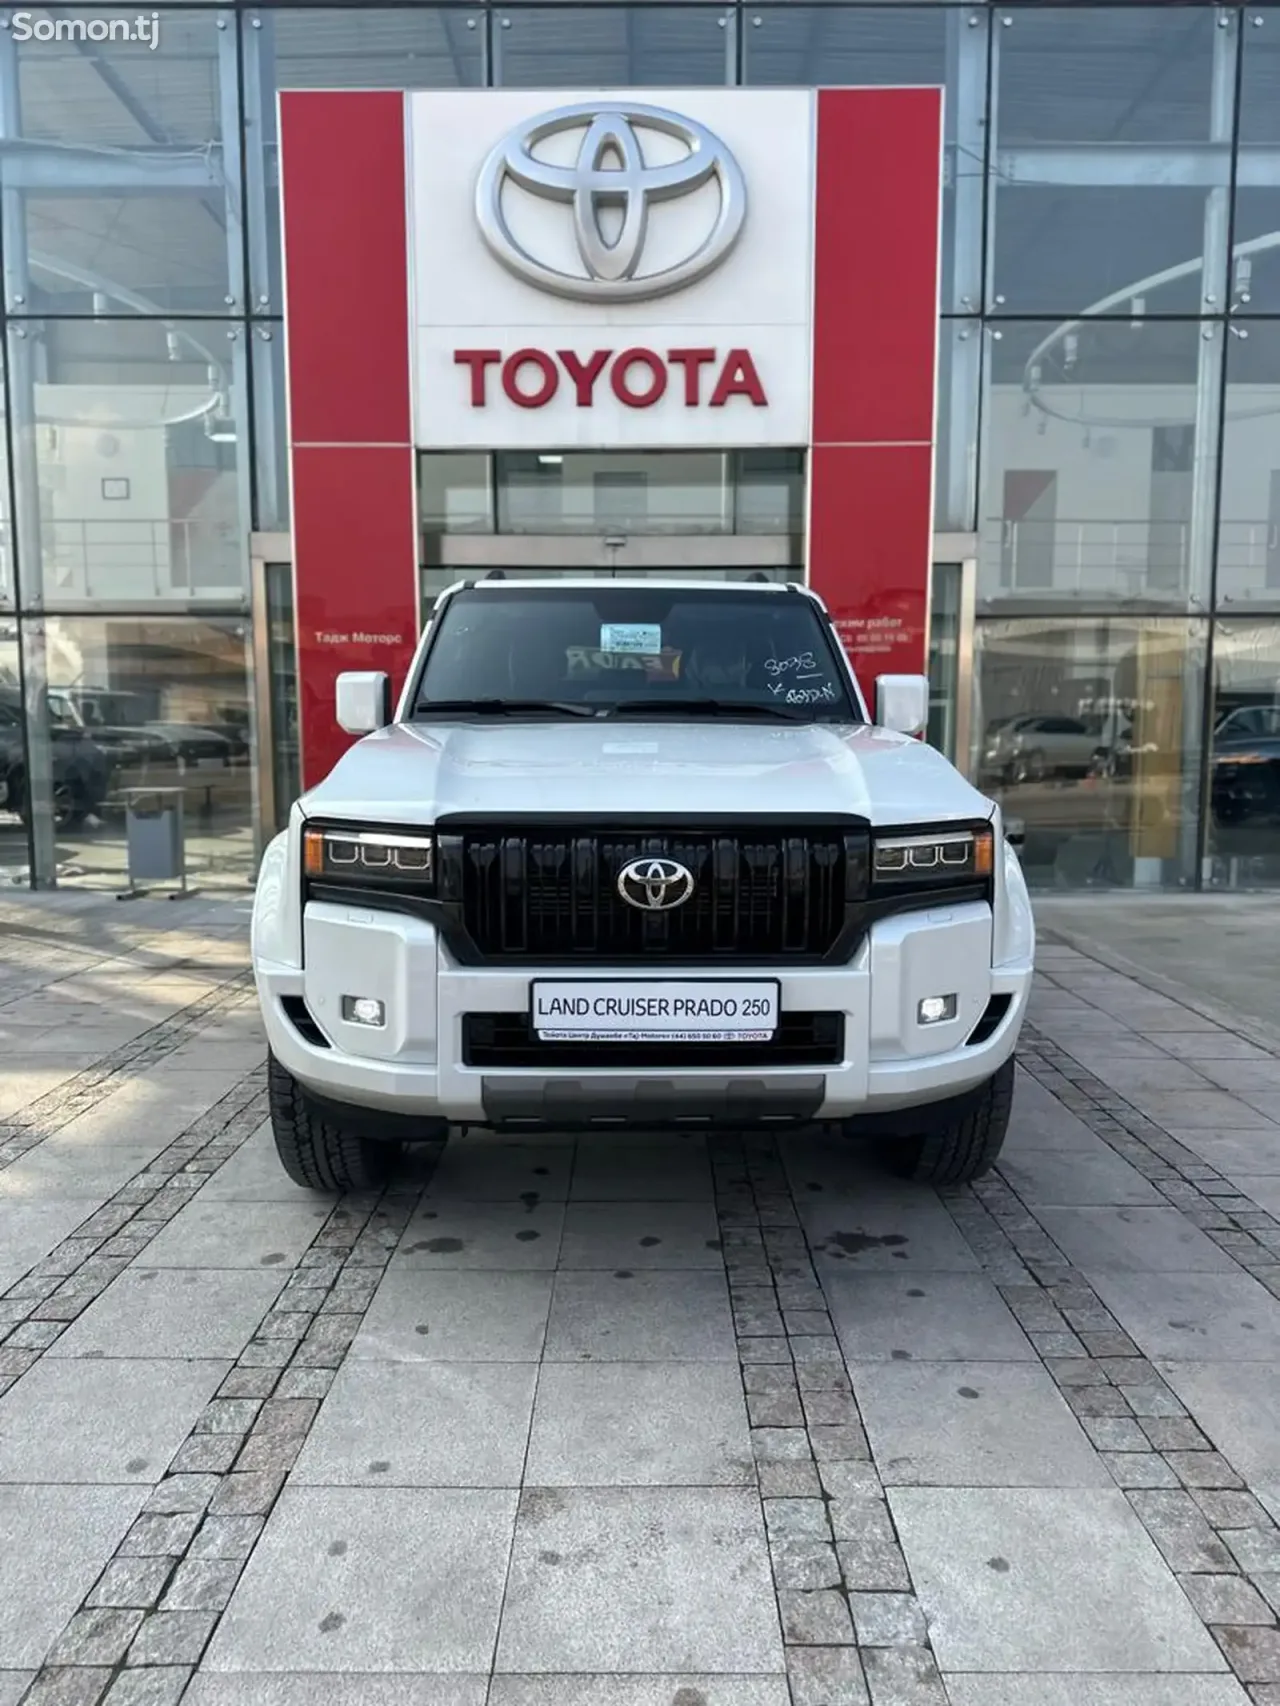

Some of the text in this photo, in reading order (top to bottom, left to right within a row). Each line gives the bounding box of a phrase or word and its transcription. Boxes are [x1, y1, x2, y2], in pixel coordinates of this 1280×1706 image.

[454, 348, 769, 409] TOYOTA
[314, 631, 402, 646] Тадж Моторс
[538, 997, 771, 1017] LAND CRUISER PRADO 250
[737, 1031, 769, 1039] TOYOTA
